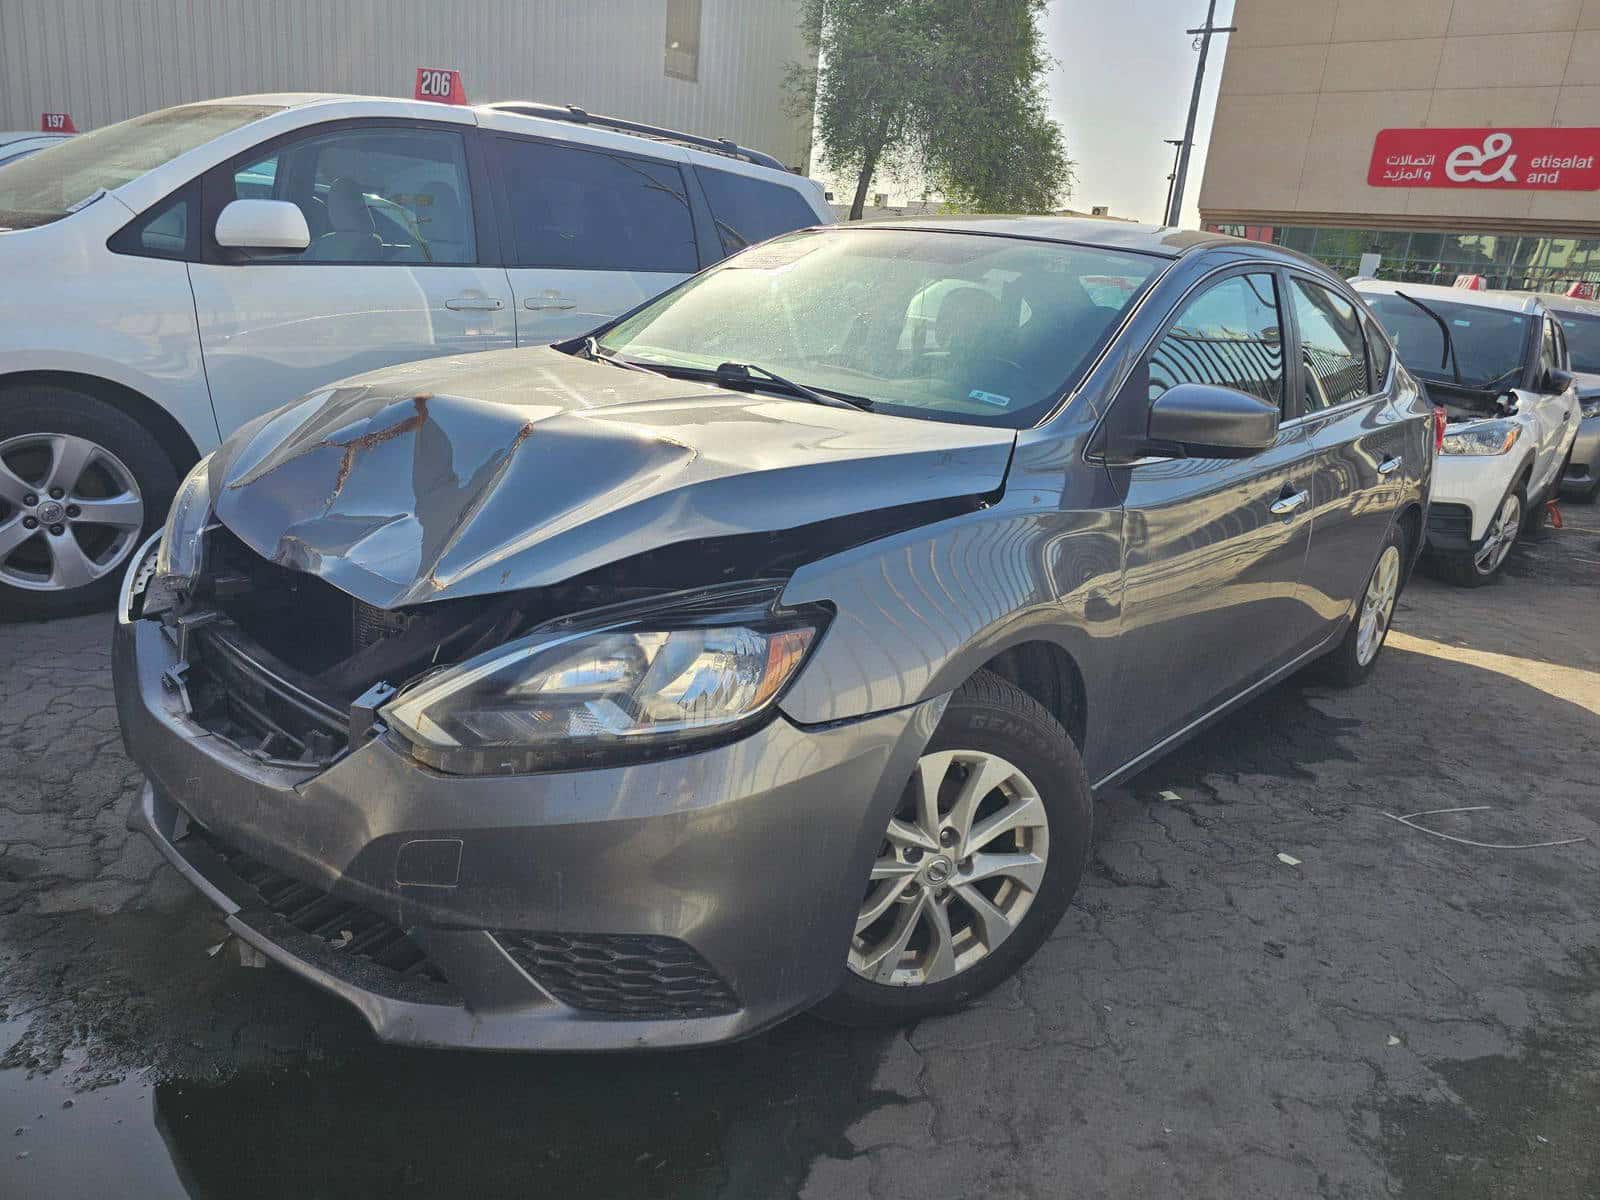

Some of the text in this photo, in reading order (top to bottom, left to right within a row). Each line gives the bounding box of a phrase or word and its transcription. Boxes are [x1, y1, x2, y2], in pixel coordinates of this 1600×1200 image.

[421, 71, 451, 97] 206
[47, 114, 65, 129] 197
[1386, 153, 1435, 166] اتصالات
[1445, 132, 1518, 183] e&
[1531, 155, 1594, 169] etisalat
[1526, 171, 1560, 184] and
